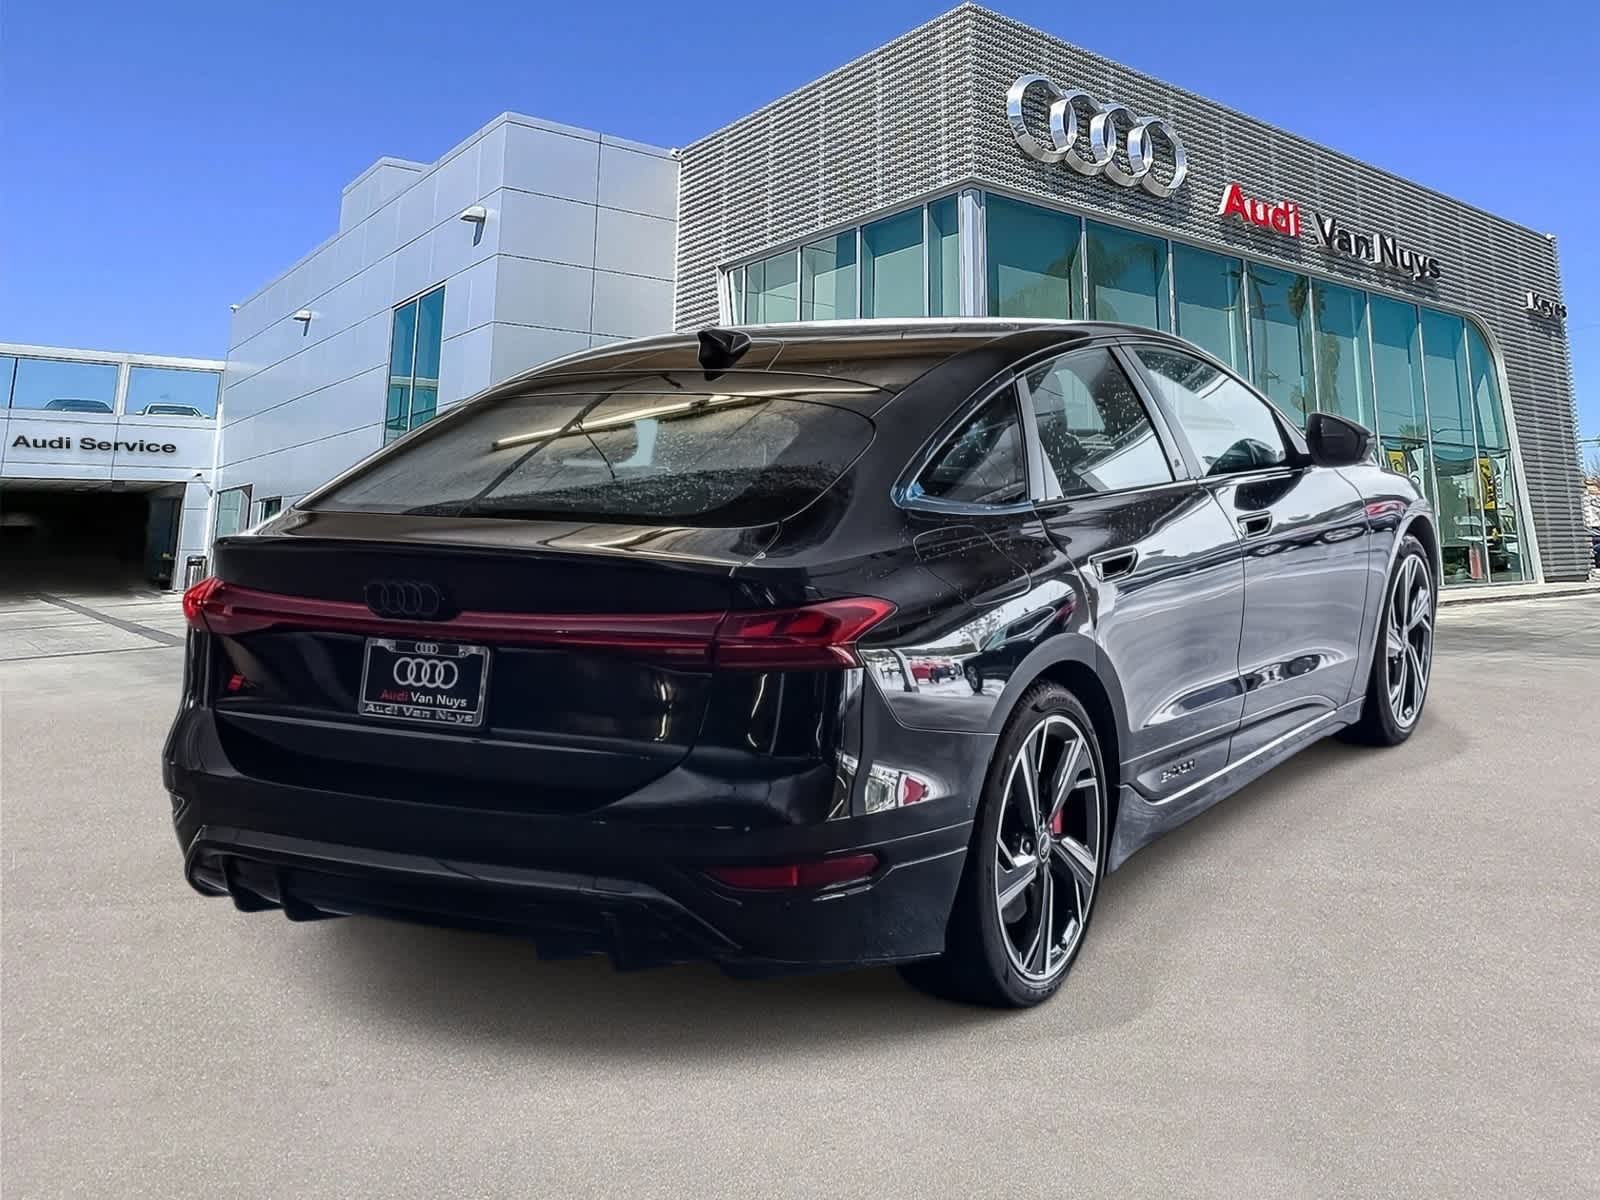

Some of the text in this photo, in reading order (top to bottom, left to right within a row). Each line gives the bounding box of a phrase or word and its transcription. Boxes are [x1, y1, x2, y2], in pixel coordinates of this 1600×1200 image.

[1218, 182, 1441, 281] Audi Van Nuys
[12, 435, 176, 453] Audi Service
[380, 689, 467, 708] Audi Van Nuys
[365, 703, 398, 715] Audi
[403, 707, 431, 719] Van
